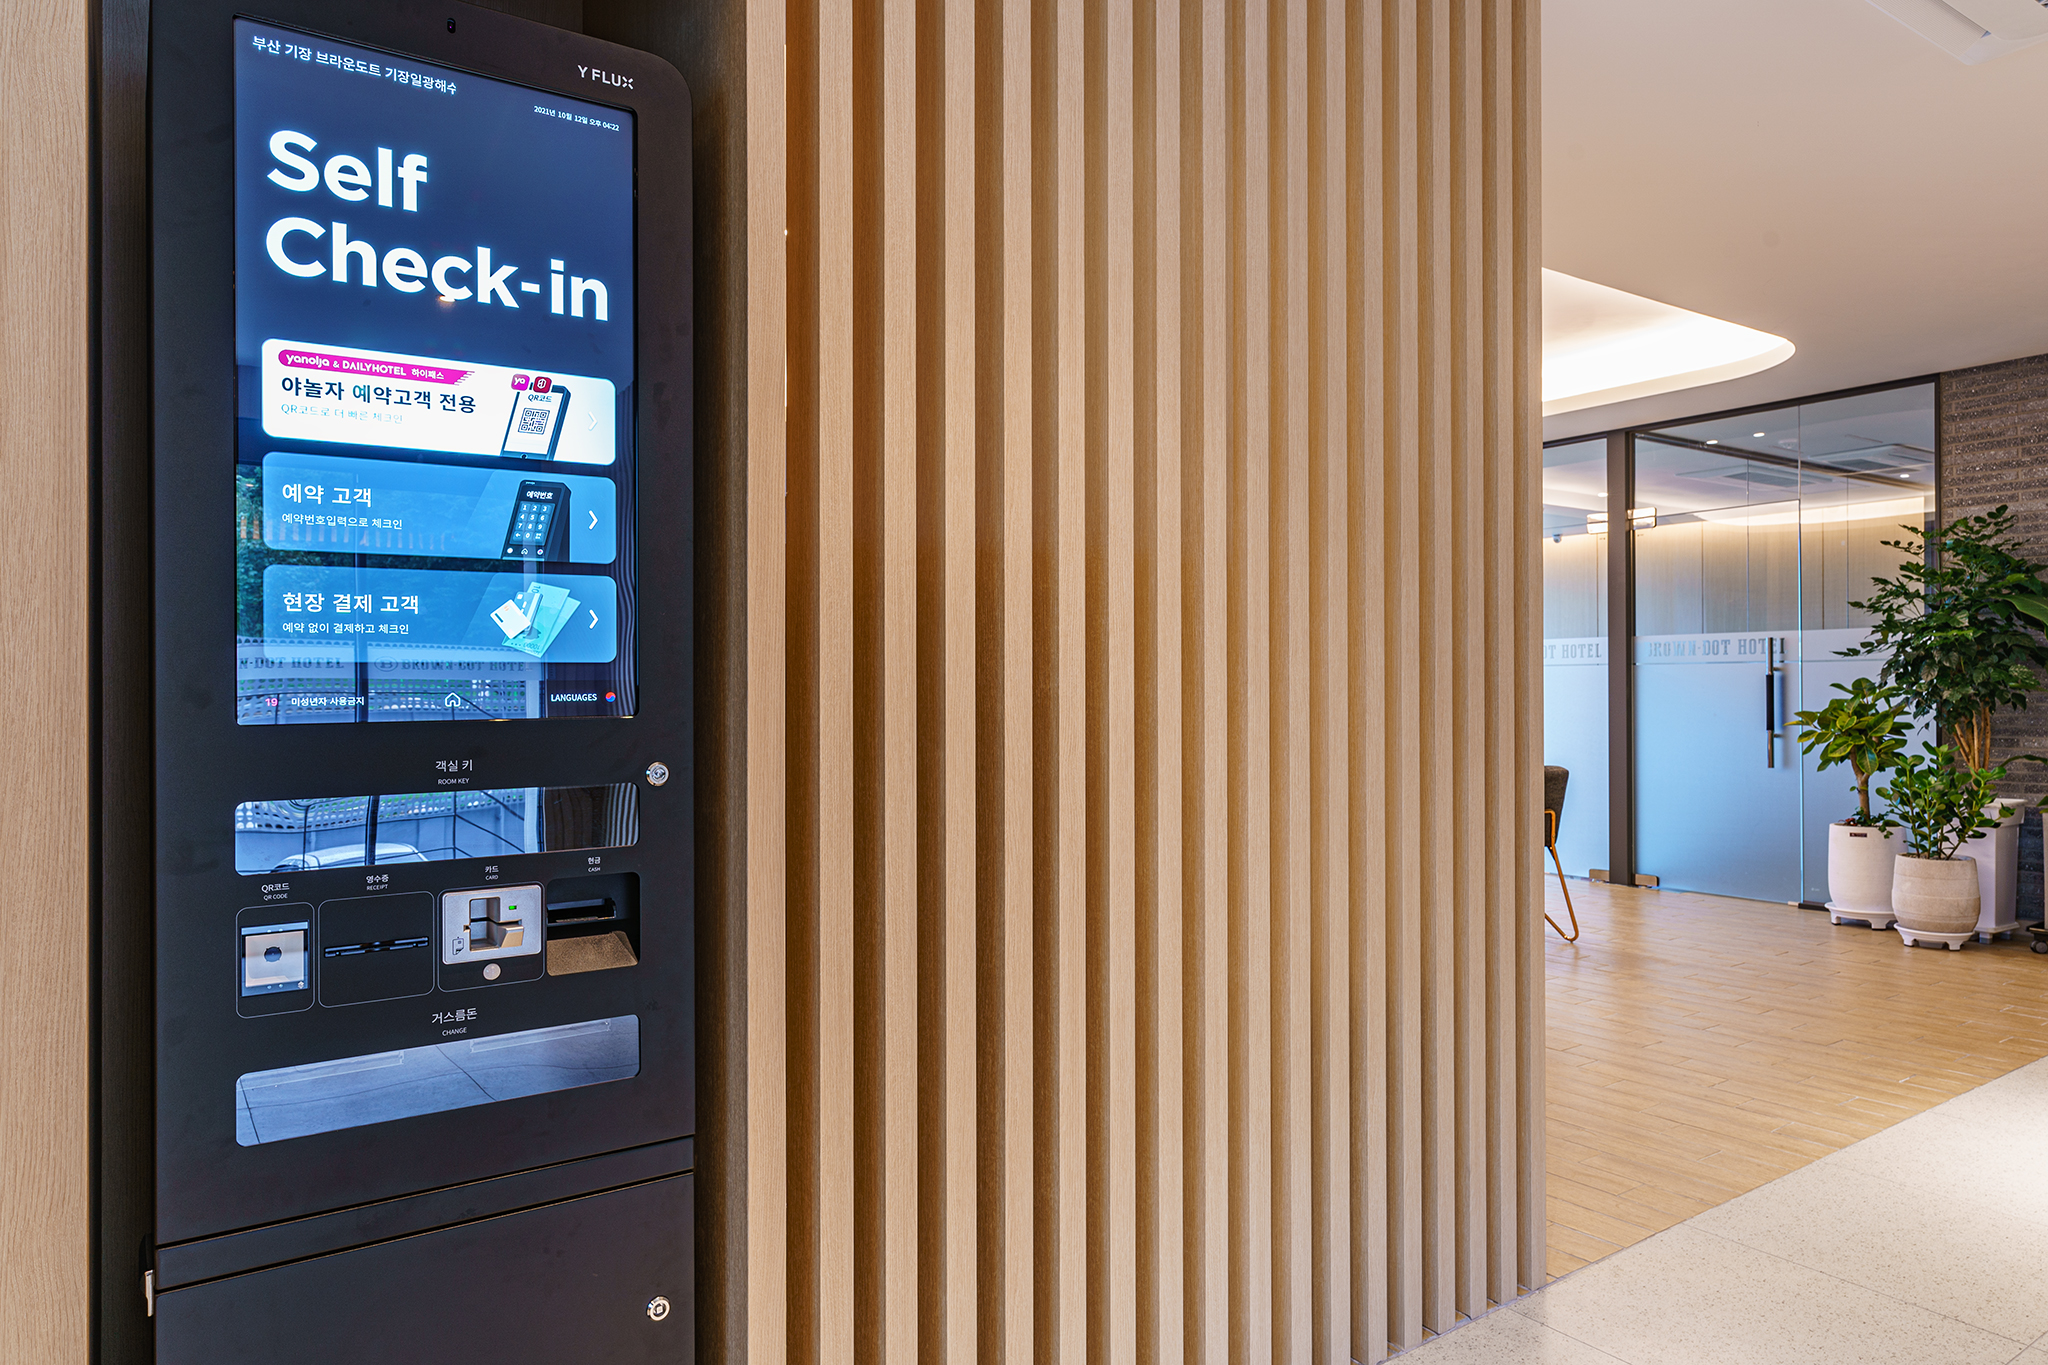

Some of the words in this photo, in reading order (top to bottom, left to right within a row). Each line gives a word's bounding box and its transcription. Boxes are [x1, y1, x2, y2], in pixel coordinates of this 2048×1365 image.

[253, 36, 281, 54] 부산
[285, 44, 312, 61] 기장
[316, 51, 381, 77] 브라운도트
[385, 67, 457, 95] 기장일광해수
[577, 64, 588, 78] Y
[591, 68, 634, 90] FLUX
[533, 105, 556, 117] 2021년
[557, 111, 573, 121] 10월
[574, 115, 588, 125] 12일
[589, 118, 601, 128] 오후
[602, 122, 620, 131] 04:22
[267, 130, 428, 212] Self
[266, 217, 609, 321] Check-in
[286, 353, 330, 368] yanolja
[342, 360, 407, 376] DAILYHOTEL
[411, 368, 445, 380] 하이패스
[281, 377, 345, 401] 야놀자
[352, 384, 431, 410] 예약고객
[439, 393, 476, 414] 전용
[281, 404, 330, 417] QR코드로
[334, 408, 344, 419] 더
[347, 410, 368, 422] 빠른
[372, 412, 403, 424] 체크인
[282, 483, 324, 504] 예약
[332, 487, 371, 508] 고객
[282, 513, 369, 527] 예약번호입력으로
[371, 518, 403, 530] 체크인
[282, 592, 325, 613] 현장
[333, 593, 372, 614] 결제
[380, 595, 419, 614] 고객
[282, 622, 305, 633] 예약
[308, 622, 330, 634] 없이
[333, 623, 376, 634] 결제하고
[378, 624, 409, 634] 체크인
[1562, 643, 1602, 658] HOTEL
[265, 698, 278, 707] 19
[291, 697, 327, 707] 미성년자
[330, 697, 365, 707] 사용금지
[550, 693, 598, 702] LANGUAGES
[435, 759, 458, 772] 객실
[462, 759, 473, 771] 키
[458, 777, 470, 785] KEY
[587, 856, 601, 865] 현금
[484, 865, 499, 874] 카드
[261, 882, 290, 893] QR코드
[365, 874, 389, 884] 영수증
[431, 1007, 477, 1024] 거스름돈
[441, 1026, 467, 1036] CHANGE
